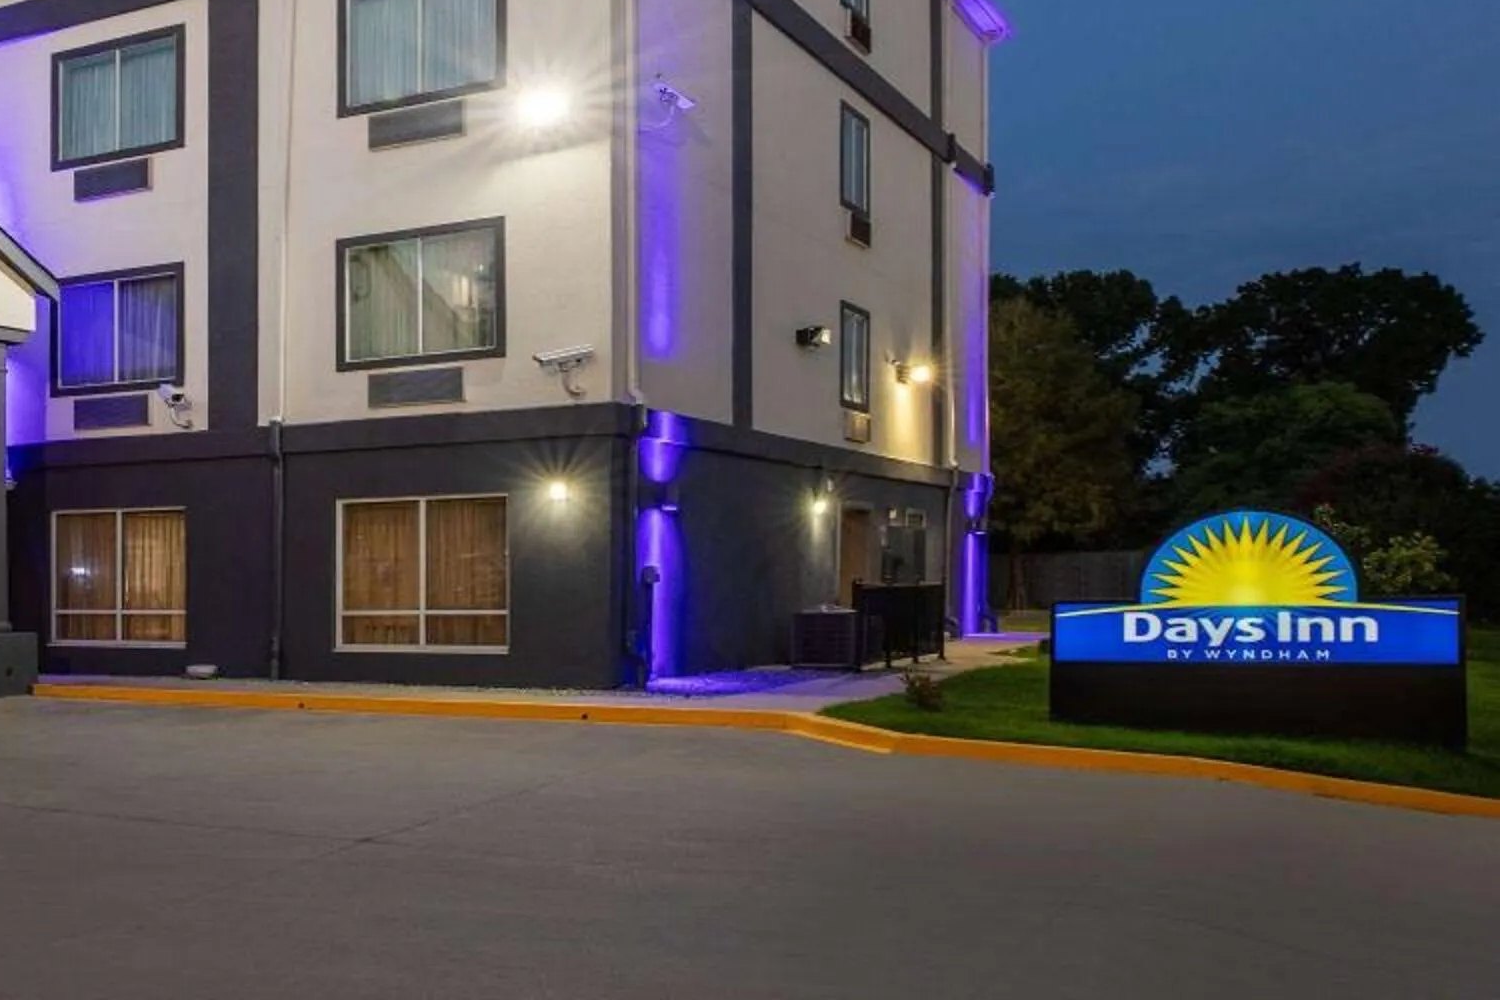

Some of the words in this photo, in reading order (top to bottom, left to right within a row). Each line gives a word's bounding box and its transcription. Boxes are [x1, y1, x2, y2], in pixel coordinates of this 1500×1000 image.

[1123, 611, 1266, 647] Days
[1277, 611, 1379, 643] Inn
[1167, 650, 1192, 660] BY
[1204, 650, 1330, 660] WYNDHAM
